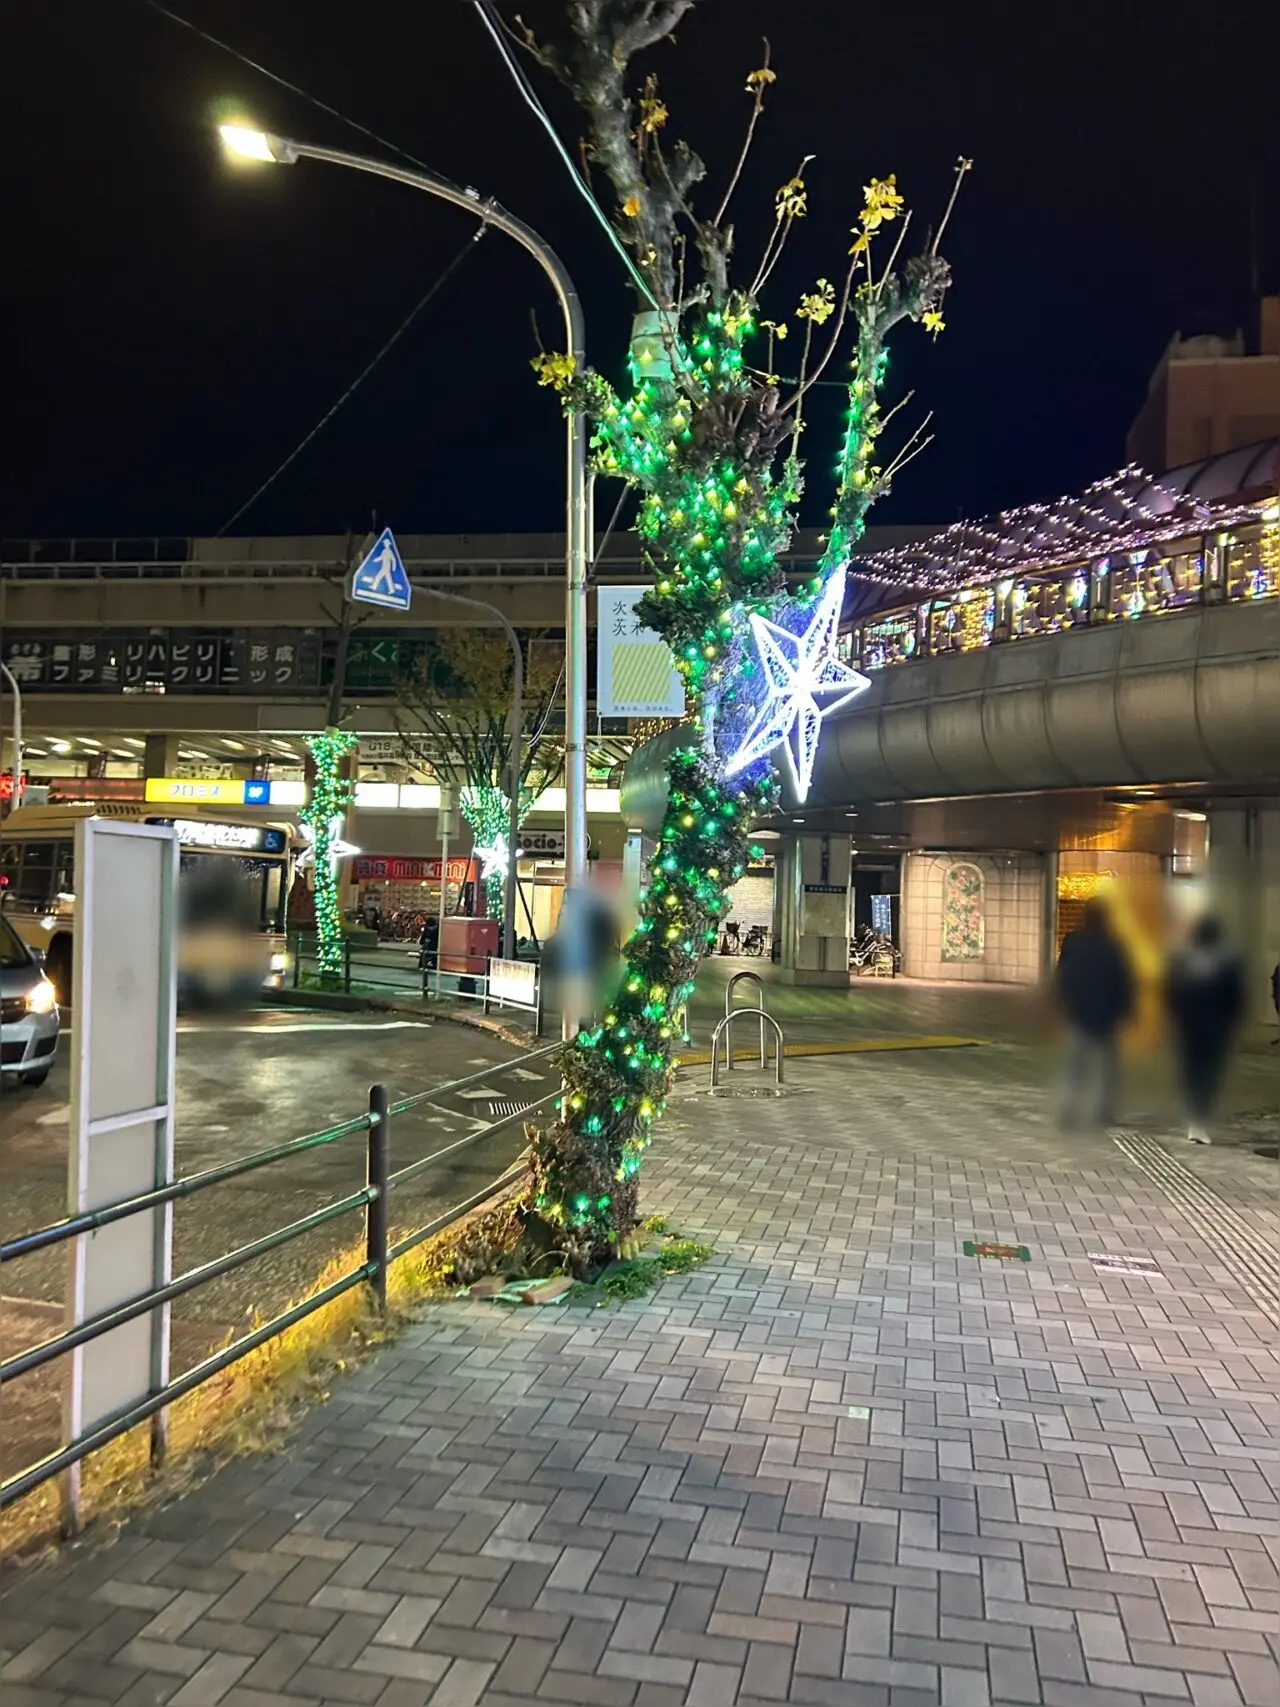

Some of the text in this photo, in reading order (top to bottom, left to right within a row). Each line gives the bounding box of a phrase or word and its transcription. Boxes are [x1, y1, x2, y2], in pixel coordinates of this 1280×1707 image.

[612, 618, 644, 636] 茨木
[53, 665, 292, 682] ファミリークリニック
